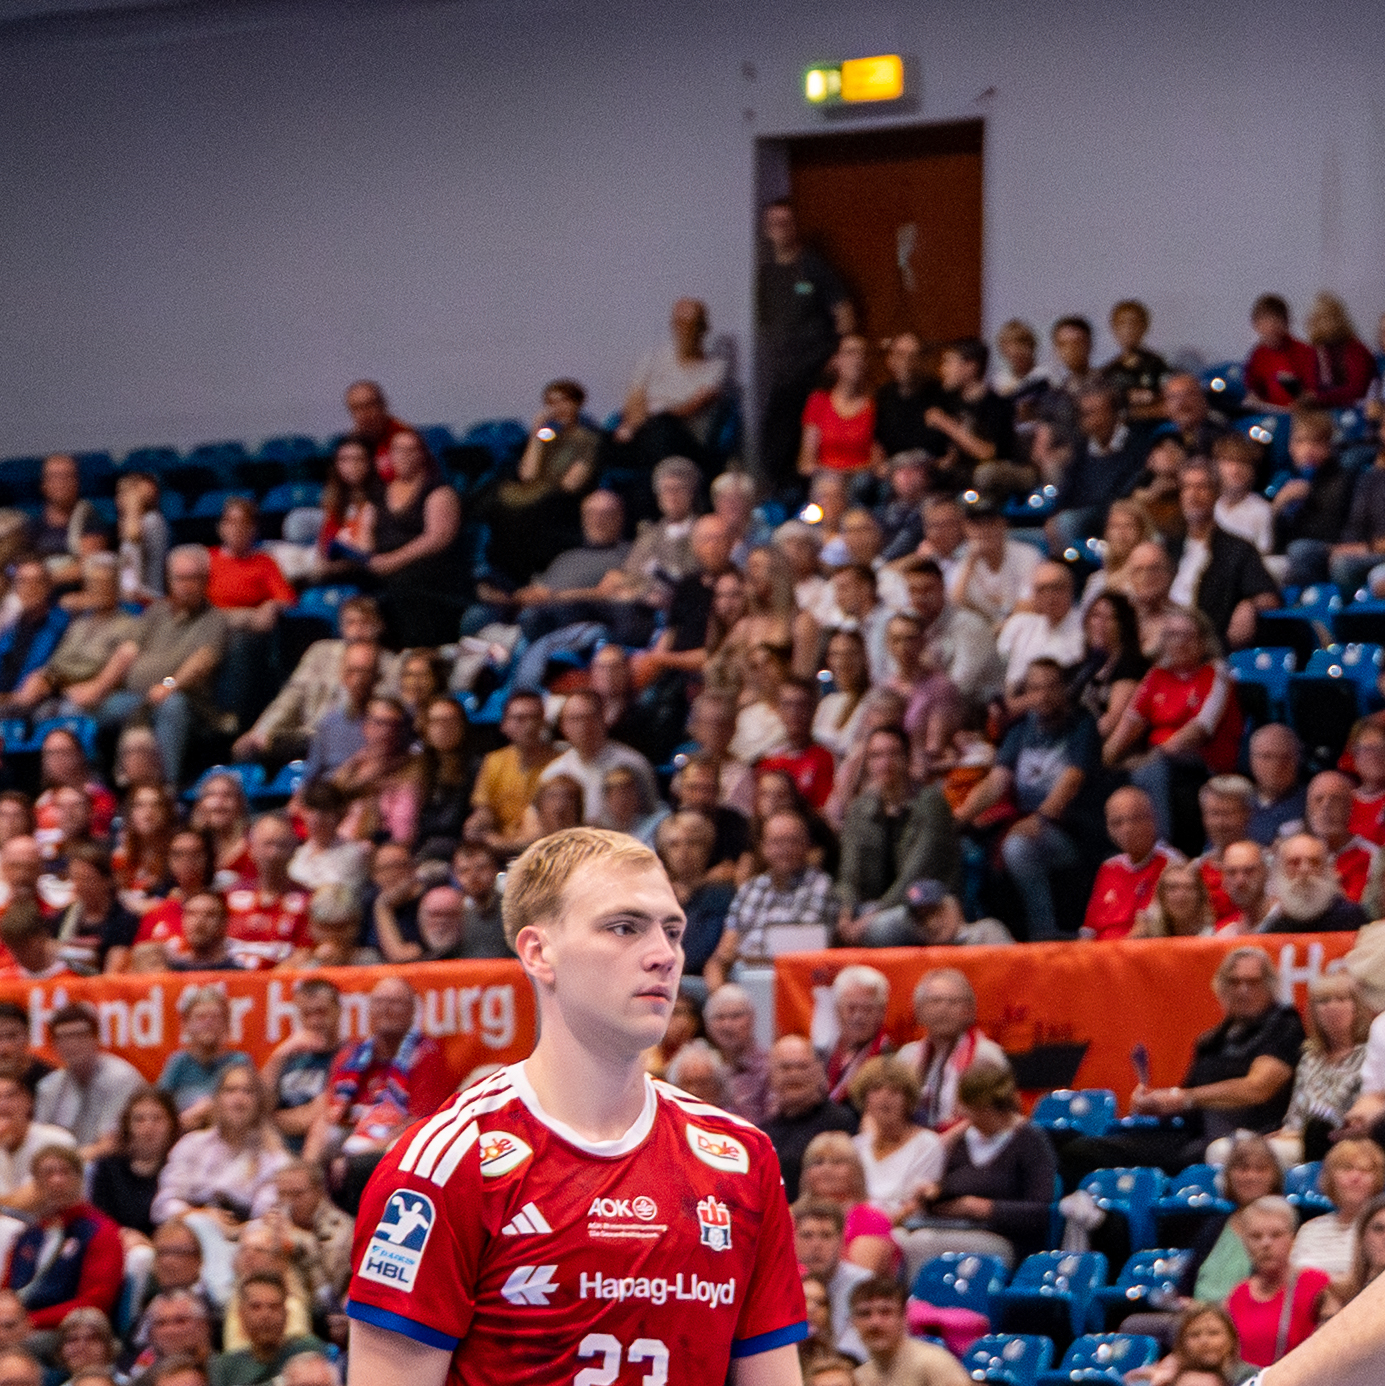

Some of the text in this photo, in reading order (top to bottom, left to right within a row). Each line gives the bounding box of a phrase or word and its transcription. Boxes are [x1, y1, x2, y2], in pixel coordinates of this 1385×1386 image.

[588, 1197, 634, 1218] AOK
[365, 1257, 410, 1285] HBL
[579, 1271, 736, 1319] Hapag-Lloyd
